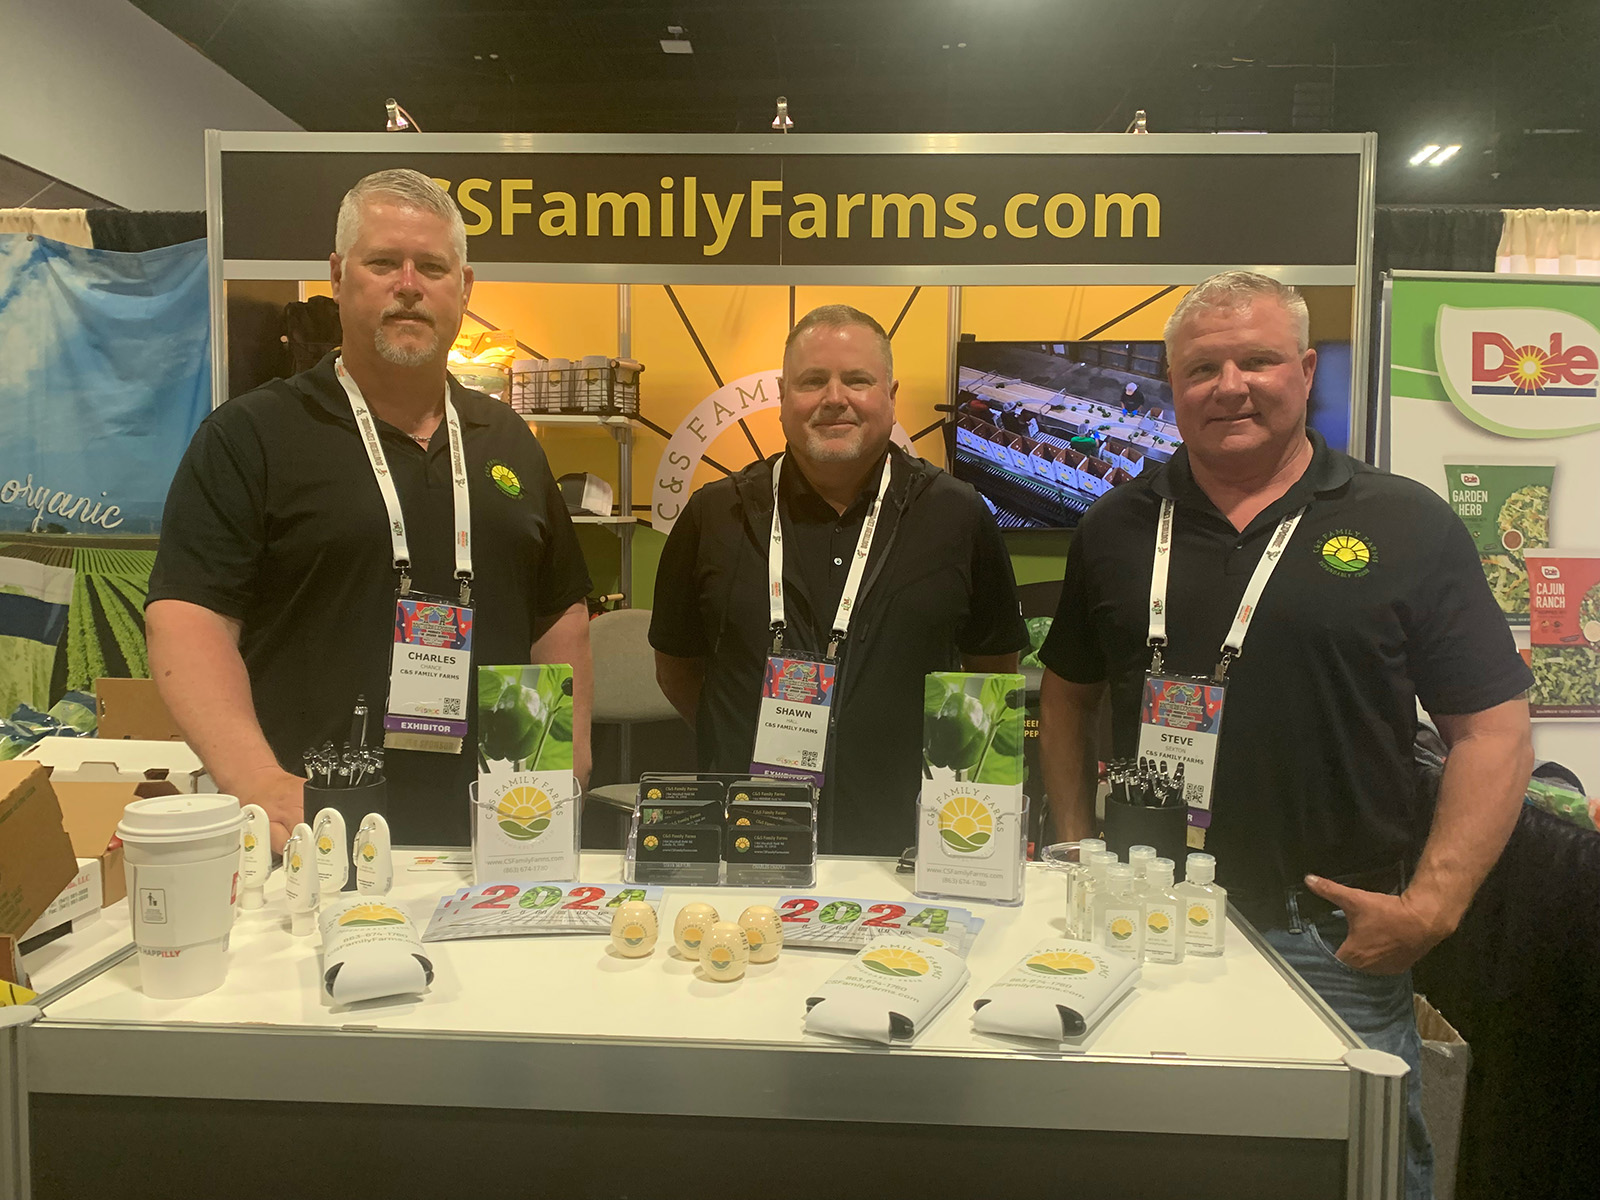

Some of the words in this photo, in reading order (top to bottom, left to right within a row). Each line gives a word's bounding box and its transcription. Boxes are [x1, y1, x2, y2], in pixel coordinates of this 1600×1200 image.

[430, 177, 1161, 256] SFamilyFarms.com
[1472, 332, 1599, 390] Dole
[657, 451, 691, 521] C&S
[1452, 490, 1488, 502] GARDEN
[1, 473, 124, 533] organic
[1459, 504, 1482, 516] HERB
[1322, 529, 1361, 540] FAMILY
[1536, 583, 1565, 595] CAJUN
[1536, 596, 1565, 608] RANCH
[408, 651, 456, 665] CHARLES
[420, 663, 442, 671] CHANCE
[414, 670, 438, 678] FAMILY
[439, 673, 460, 681] FARMS
[776, 706, 812, 719] SHAWN
[401, 722, 451, 733] EXHIBITOR
[765, 721, 776, 729] C&S
[777, 723, 798, 732] FAMILY
[1160, 733, 1194, 747] STEVE
[1159, 752, 1182, 761] FAMILY
[1183, 756, 1204, 765] FARMS
[494, 776, 539, 797] FAMILY
[541, 781, 564, 816] FARMS
[935, 787, 980, 804] FAMILY
[982, 795, 1005, 833] FARMS
[926, 867, 1004, 879] www.CSFamilyFarms.com
[472, 885, 647, 910] 2024
[781, 898, 949, 934] 2024
